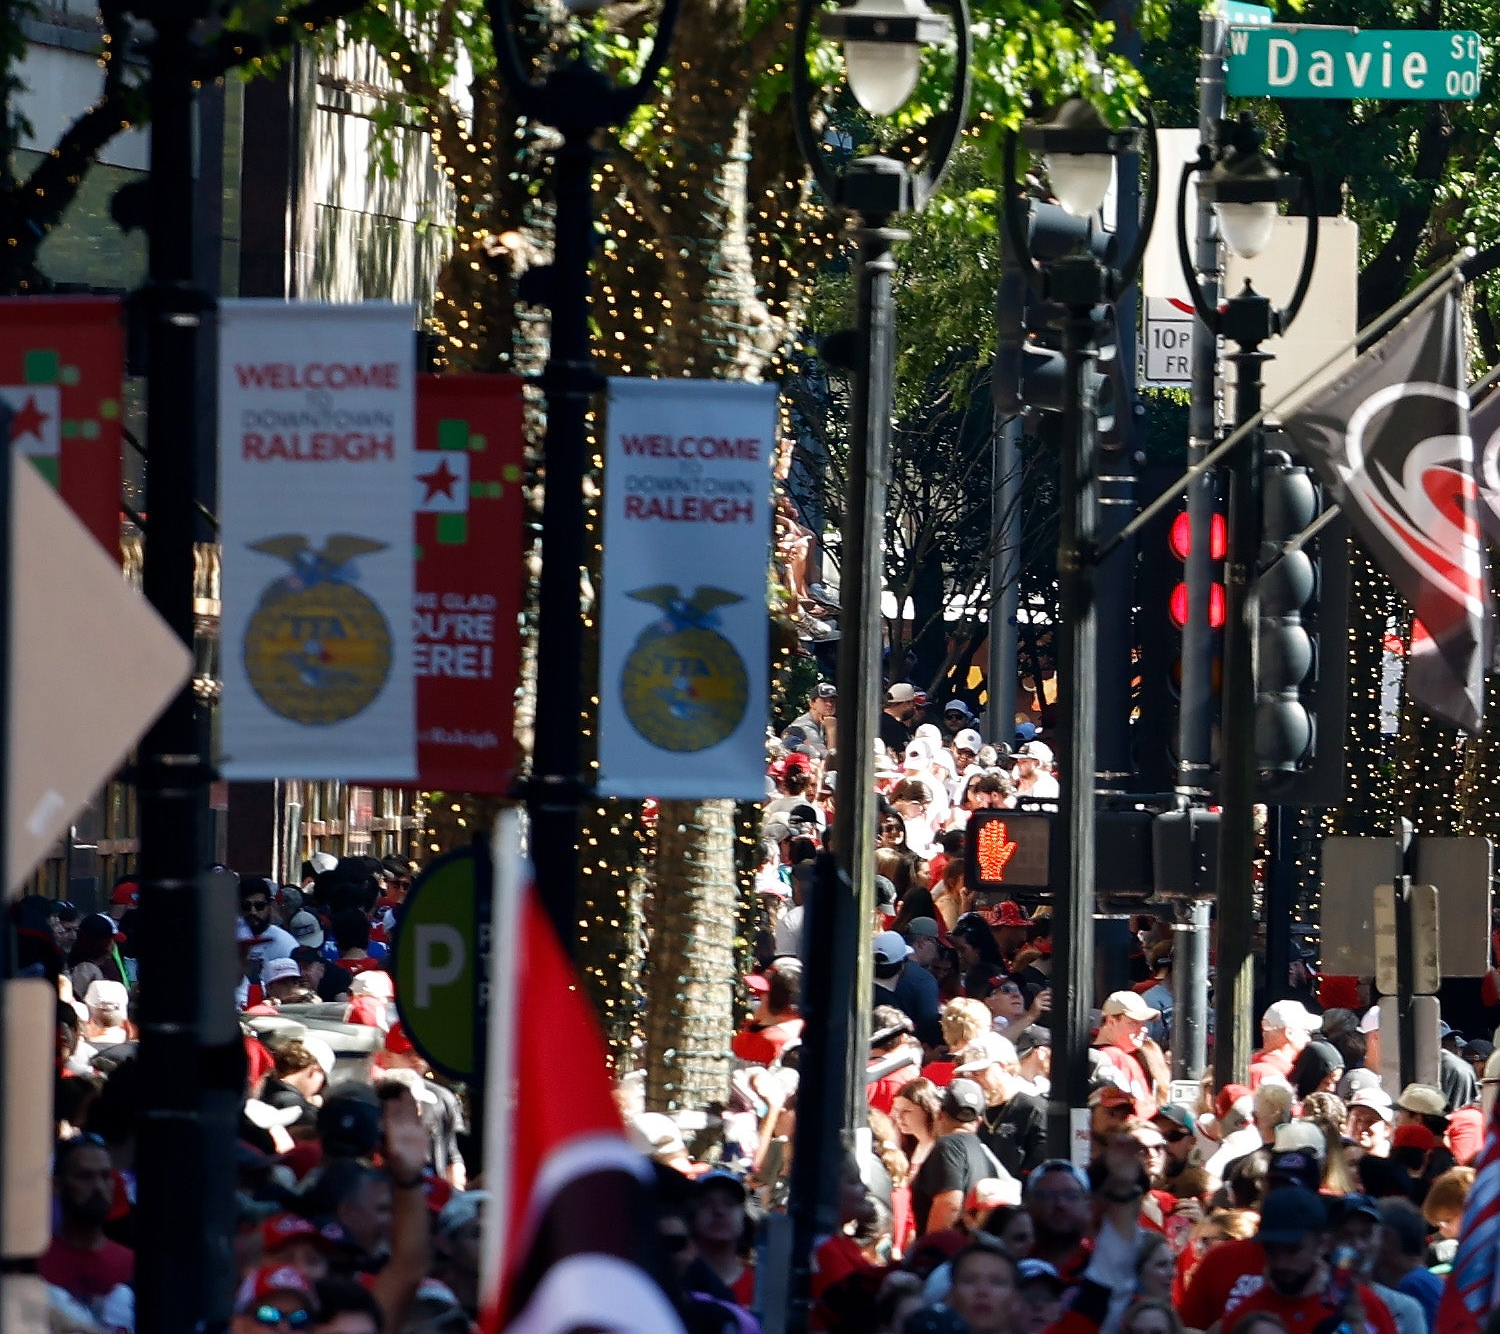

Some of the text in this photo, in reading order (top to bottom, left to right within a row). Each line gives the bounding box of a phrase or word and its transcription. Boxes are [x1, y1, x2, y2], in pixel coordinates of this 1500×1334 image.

[1230, 31, 1476, 88] W Davie St
[1445, 70, 1475, 96] 00
[234, 362, 400, 389] WELCOME
[242, 433, 394, 461] RALEIGH
[621, 434, 762, 461] WELCOME
[624, 494, 754, 523] RALEIGH
[412, 614, 495, 641] OU'RE
[413, 643, 493, 678] ERE!
